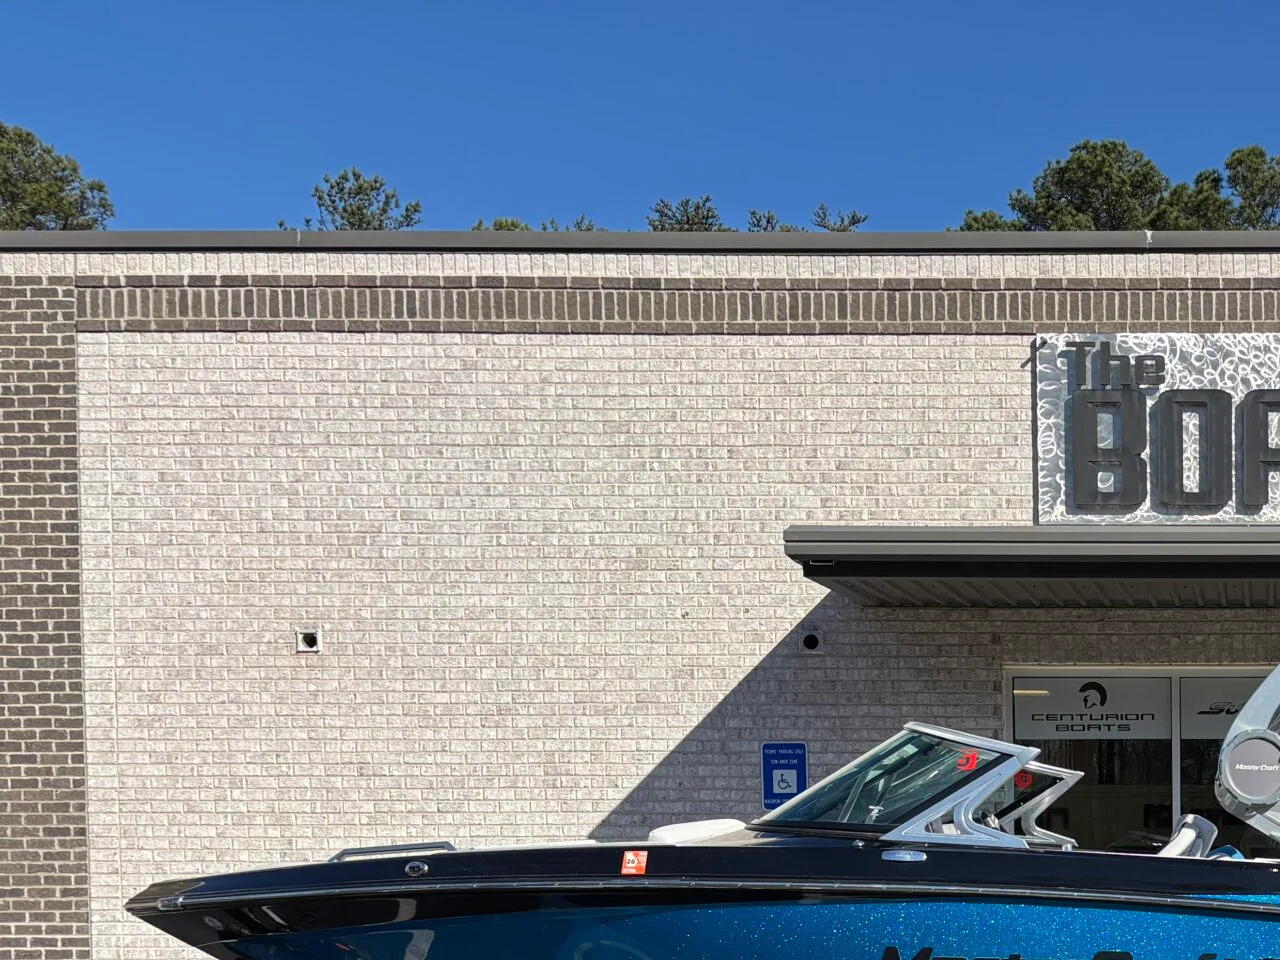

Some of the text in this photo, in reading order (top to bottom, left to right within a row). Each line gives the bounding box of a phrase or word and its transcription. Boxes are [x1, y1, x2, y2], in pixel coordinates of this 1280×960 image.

[1065, 341, 1166, 386] The
[1031, 713, 1155, 721] CENTURION
[1055, 723, 1131, 732] BOATS
[1234, 763, 1280, 771] MasterCraft
